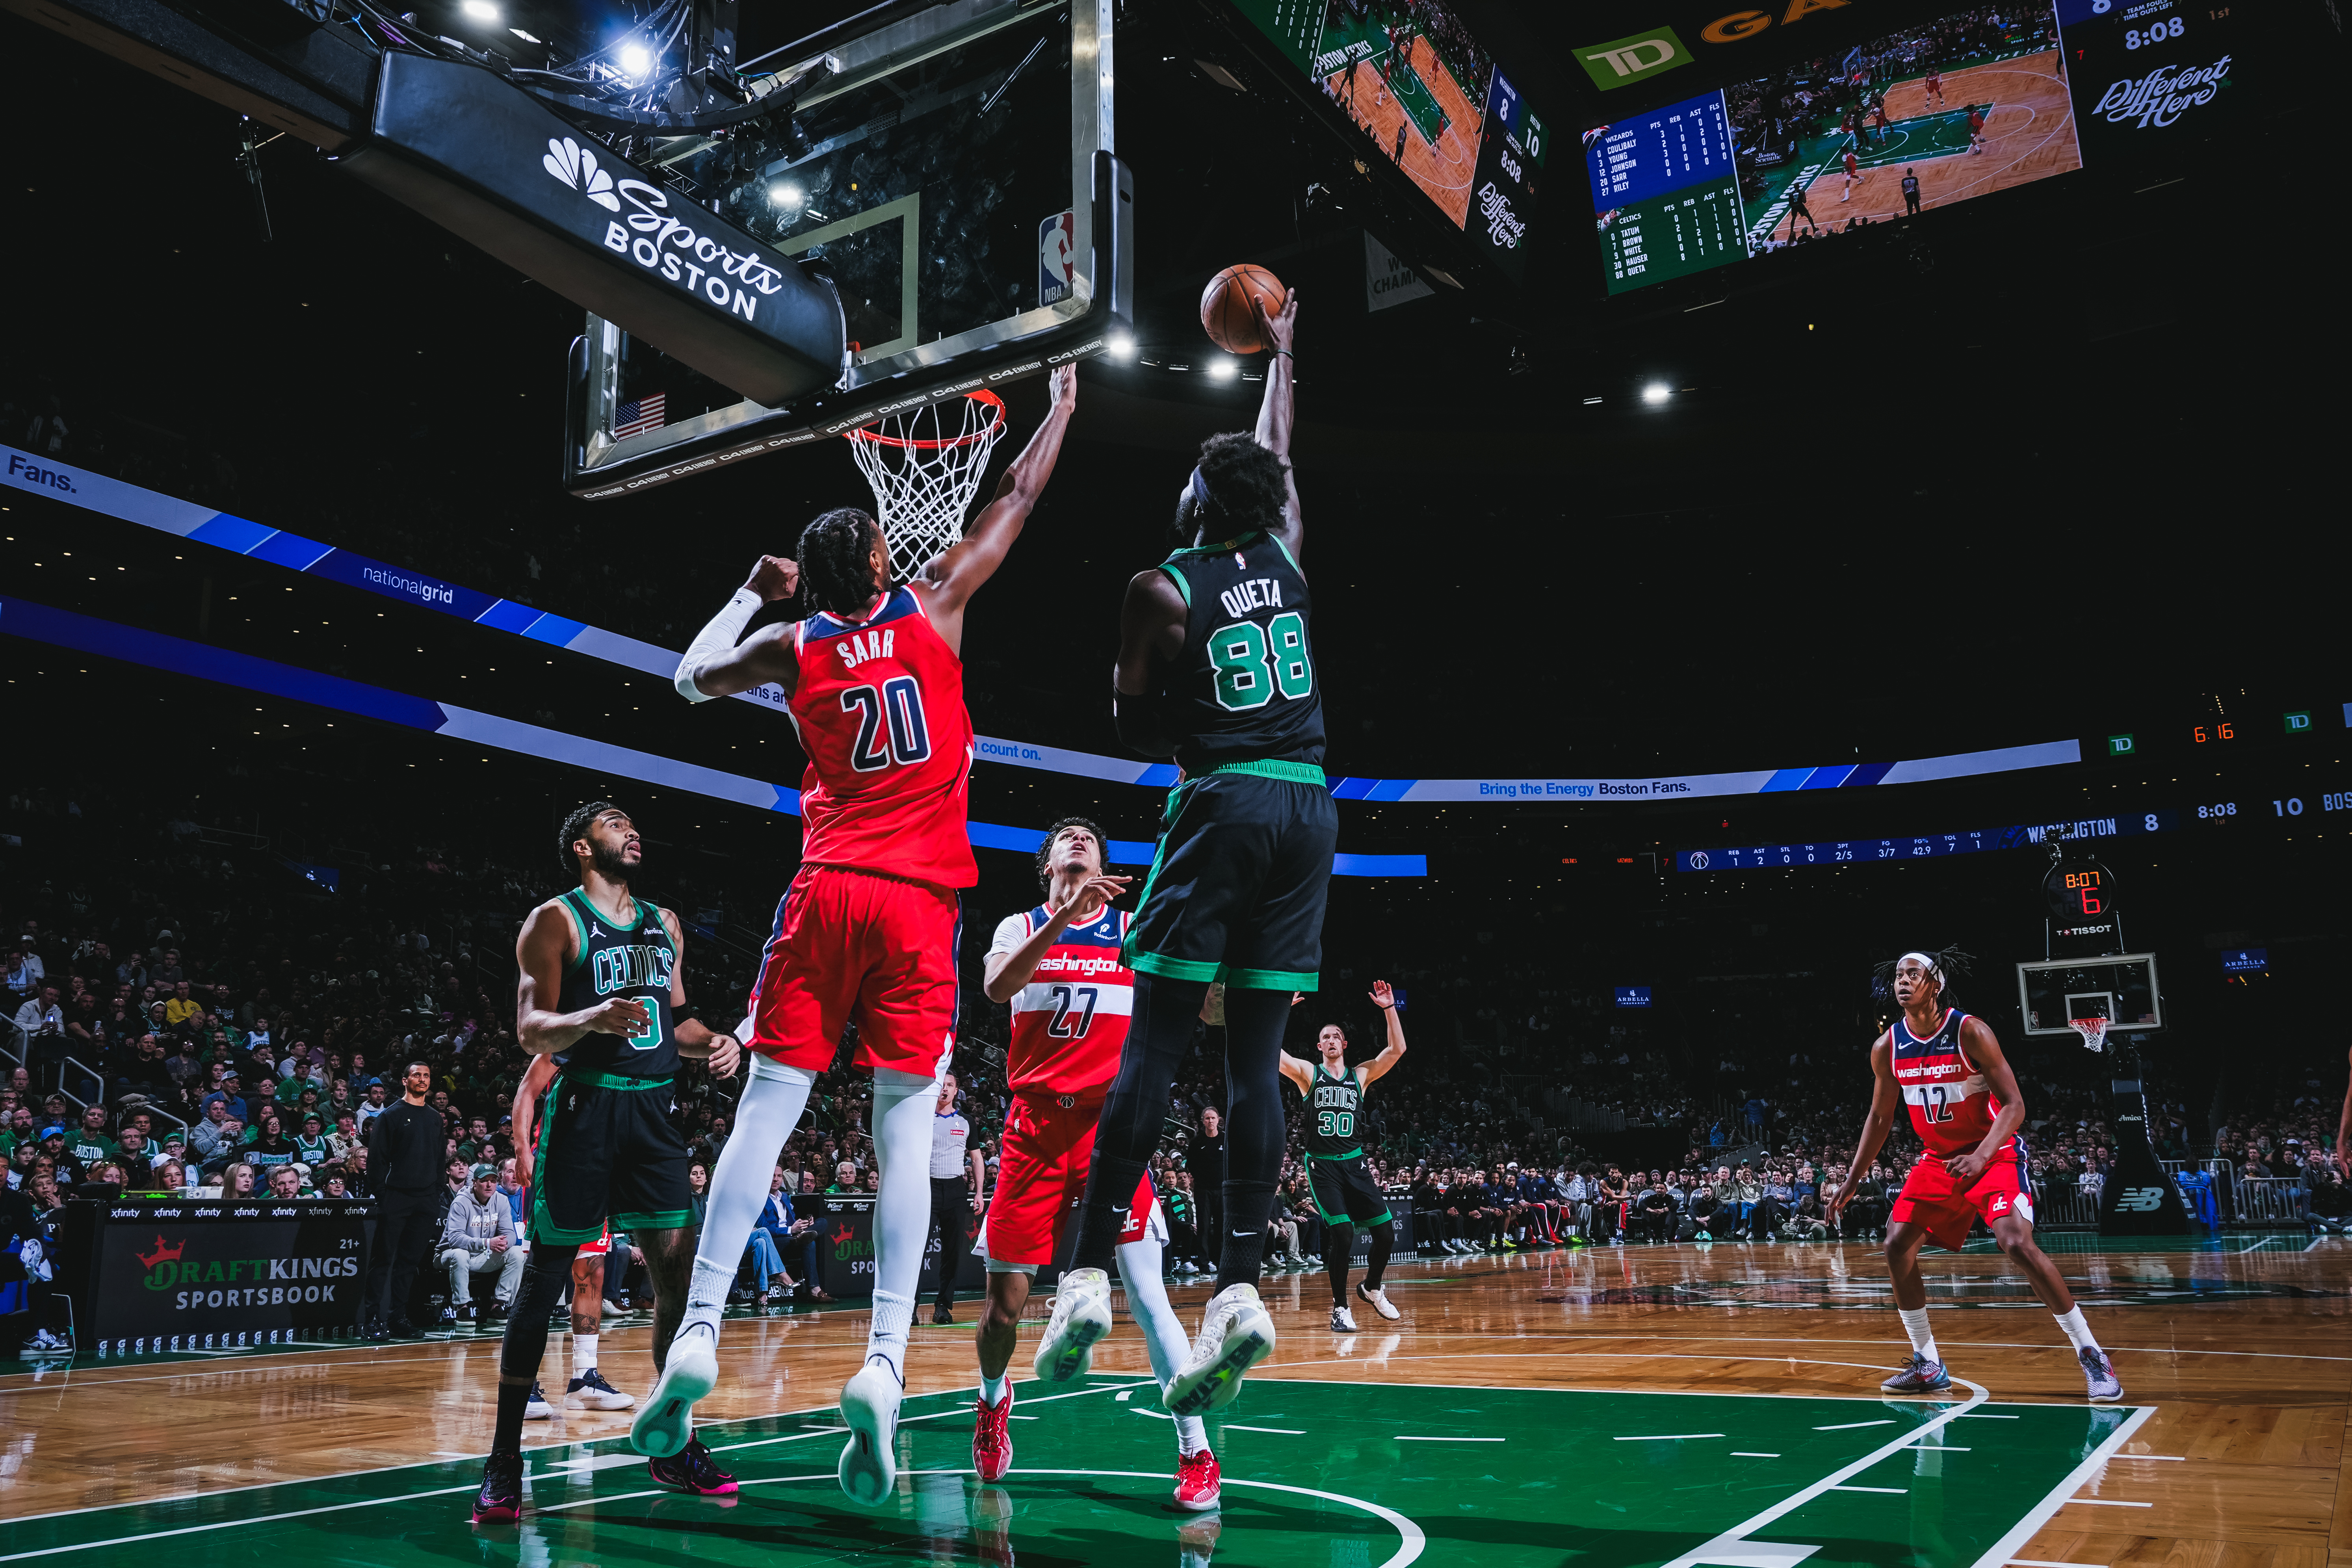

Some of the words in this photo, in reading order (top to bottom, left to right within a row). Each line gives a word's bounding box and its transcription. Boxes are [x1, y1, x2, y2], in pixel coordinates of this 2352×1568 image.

[2123, 10, 2139, 21] TIME
[2140, 6, 2158, 16] OUTS
[2159, 1, 2174, 11] LEFT
[2127, 4, 2145, 14] TEAM
[2146, 0, 2168, 8] FOULS
[2209, 7, 2230, 20] 1st
[2125, 17, 2185, 50] 8:08
[1586, 39, 1675, 76] TD
[2077, 50, 2084, 60] 7
[2092, 55, 2232, 122] Different
[1499, 76, 1516, 101] WASHINGTON
[1530, 114, 1540, 132] BOSTON
[2136, 81, 2217, 129] Here
[1670, 115, 1681, 124] REB
[1690, 108, 1701, 117] AST
[1710, 103, 1719, 111] FLS
[1500, 98, 1508, 121] 8
[1526, 128, 1539, 157] 10
[1605, 130, 1633, 143] WIZARDS
[1607, 139, 1637, 154] COULIBALY
[1501, 150, 1521, 183] 8:08
[1609, 152, 1627, 164] YOUNG
[1611, 159, 1637, 174] JOHNSON
[1755, 153, 1782, 163] Scientific
[1600, 178, 1608, 187] 20
[1612, 172, 1627, 183] SARR
[1602, 188, 1609, 196] 27
[1614, 181, 1629, 193] RILEY
[1683, 198, 1694, 207] REB
[1704, 192, 1715, 201] AST
[1724, 187, 1733, 195] FLS
[1477, 181, 1525, 237] Different
[1619, 213, 1641, 224] CELTICS
[618, 179, 782, 294] Sports
[1487, 215, 1517, 249] Here
[1621, 226, 1640, 238] TATUM
[1622, 235, 1642, 247] BROWN
[1624, 245, 1642, 257] WHITE
[1614, 261, 1622, 269] 30
[1626, 254, 1648, 266] HAUSER
[604, 221, 757, 321] BOSTON
[1616, 271, 1623, 279] 88
[1627, 264, 1646, 276] QUETA
[1045, 284, 1061, 303] NBA
[1047, 351, 1074, 363] C4
[1072, 340, 1102, 355] ENERGY
[988, 370, 1014, 381] C4
[1012, 361, 1042, 373] ENERGY
[932, 387, 957, 397] C4
[954, 378, 984, 391] ENERGY
[878, 403, 902, 414] C4
[900, 395, 928, 407] ENERGY
[826, 422, 849, 433] C4
[847, 411, 874, 424] ENERGY
[768, 438, 791, 446] C4
[789, 433, 815, 442] ENERGY
[719, 451, 741, 461] C4
[739, 444, 765, 455] ENERGY
[9, 454, 76, 494] Fans.
[673, 465, 695, 475] C4
[691, 458, 716, 470] ENERGY
[627, 479, 648, 488] C4
[646, 473, 670, 483] ENERGY
[601, 487, 624, 495] ENERGY
[364, 567, 453, 604] nationalgrid
[1221, 578, 1283, 618] QUETA
[836, 629, 895, 669] SARR
[1207, 612, 1312, 712] 88
[747, 686, 769, 699] ans
[840, 675, 931, 773] 20
[2287, 714, 2309, 729] TD
[981, 743, 1018, 758] count
[1022, 749, 1041, 761] on.
[2111, 738, 2132, 751] TD
[1480, 783, 1517, 797] Bring
[1520, 783, 1542, 794] the
[1546, 782, 1594, 797] Energy
[1599, 782, 1648, 795] Boston
[1652, 782, 1691, 793] Fans.
[2145, 814, 2159, 831] 8
[2198, 803, 2237, 818] 8:08
[2273, 798, 2304, 817] 10
[1757, 856, 1763, 865] 2
[1784, 855, 1790, 863] 0
[1808, 853, 1814, 862] 0
[1835, 850, 1852, 860] 2/5
[1878, 848, 1895, 858] 3/7
[1912, 846, 1931, 855] 42.9
[1949, 843, 1955, 852] 7
[1975, 840, 1980, 849] 1
[2065, 871, 2100, 888] 8:07
[2081, 887, 2101, 914] 6
[1094, 932, 1117, 940] Robinhood
[2071, 925, 2112, 935] TISSOT
[593, 945, 673, 995] CELTICS
[1048, 985, 1098, 1039] 27
[1897, 1063, 1961, 1078] washington
[1314, 1086, 1357, 1111] CELTICS
[1919, 1085, 1954, 1124] 12
[1318, 1111, 1354, 1137] 30
[75, 1144, 103, 1158] BOSTON
[303, 1150, 324, 1160] BOSTON
[111, 1208, 140, 1218] xfinity
[153, 1208, 182, 1218] xfinity
[195, 1208, 221, 1217] xfinity
[234, 1207, 260, 1217] xfinity
[272, 1207, 297, 1217] xfinity
[309, 1207, 333, 1216] xfinity
[344, 1207, 368, 1215] xfinity
[1992, 1196, 2008, 1211] dc
[340, 1239, 360, 1249] 21+
[144, 1257, 358, 1291] DRAFTKINGS
[176, 1285, 335, 1310] SPORTSBOOK
[766, 1285, 793, 1299] etBlue
